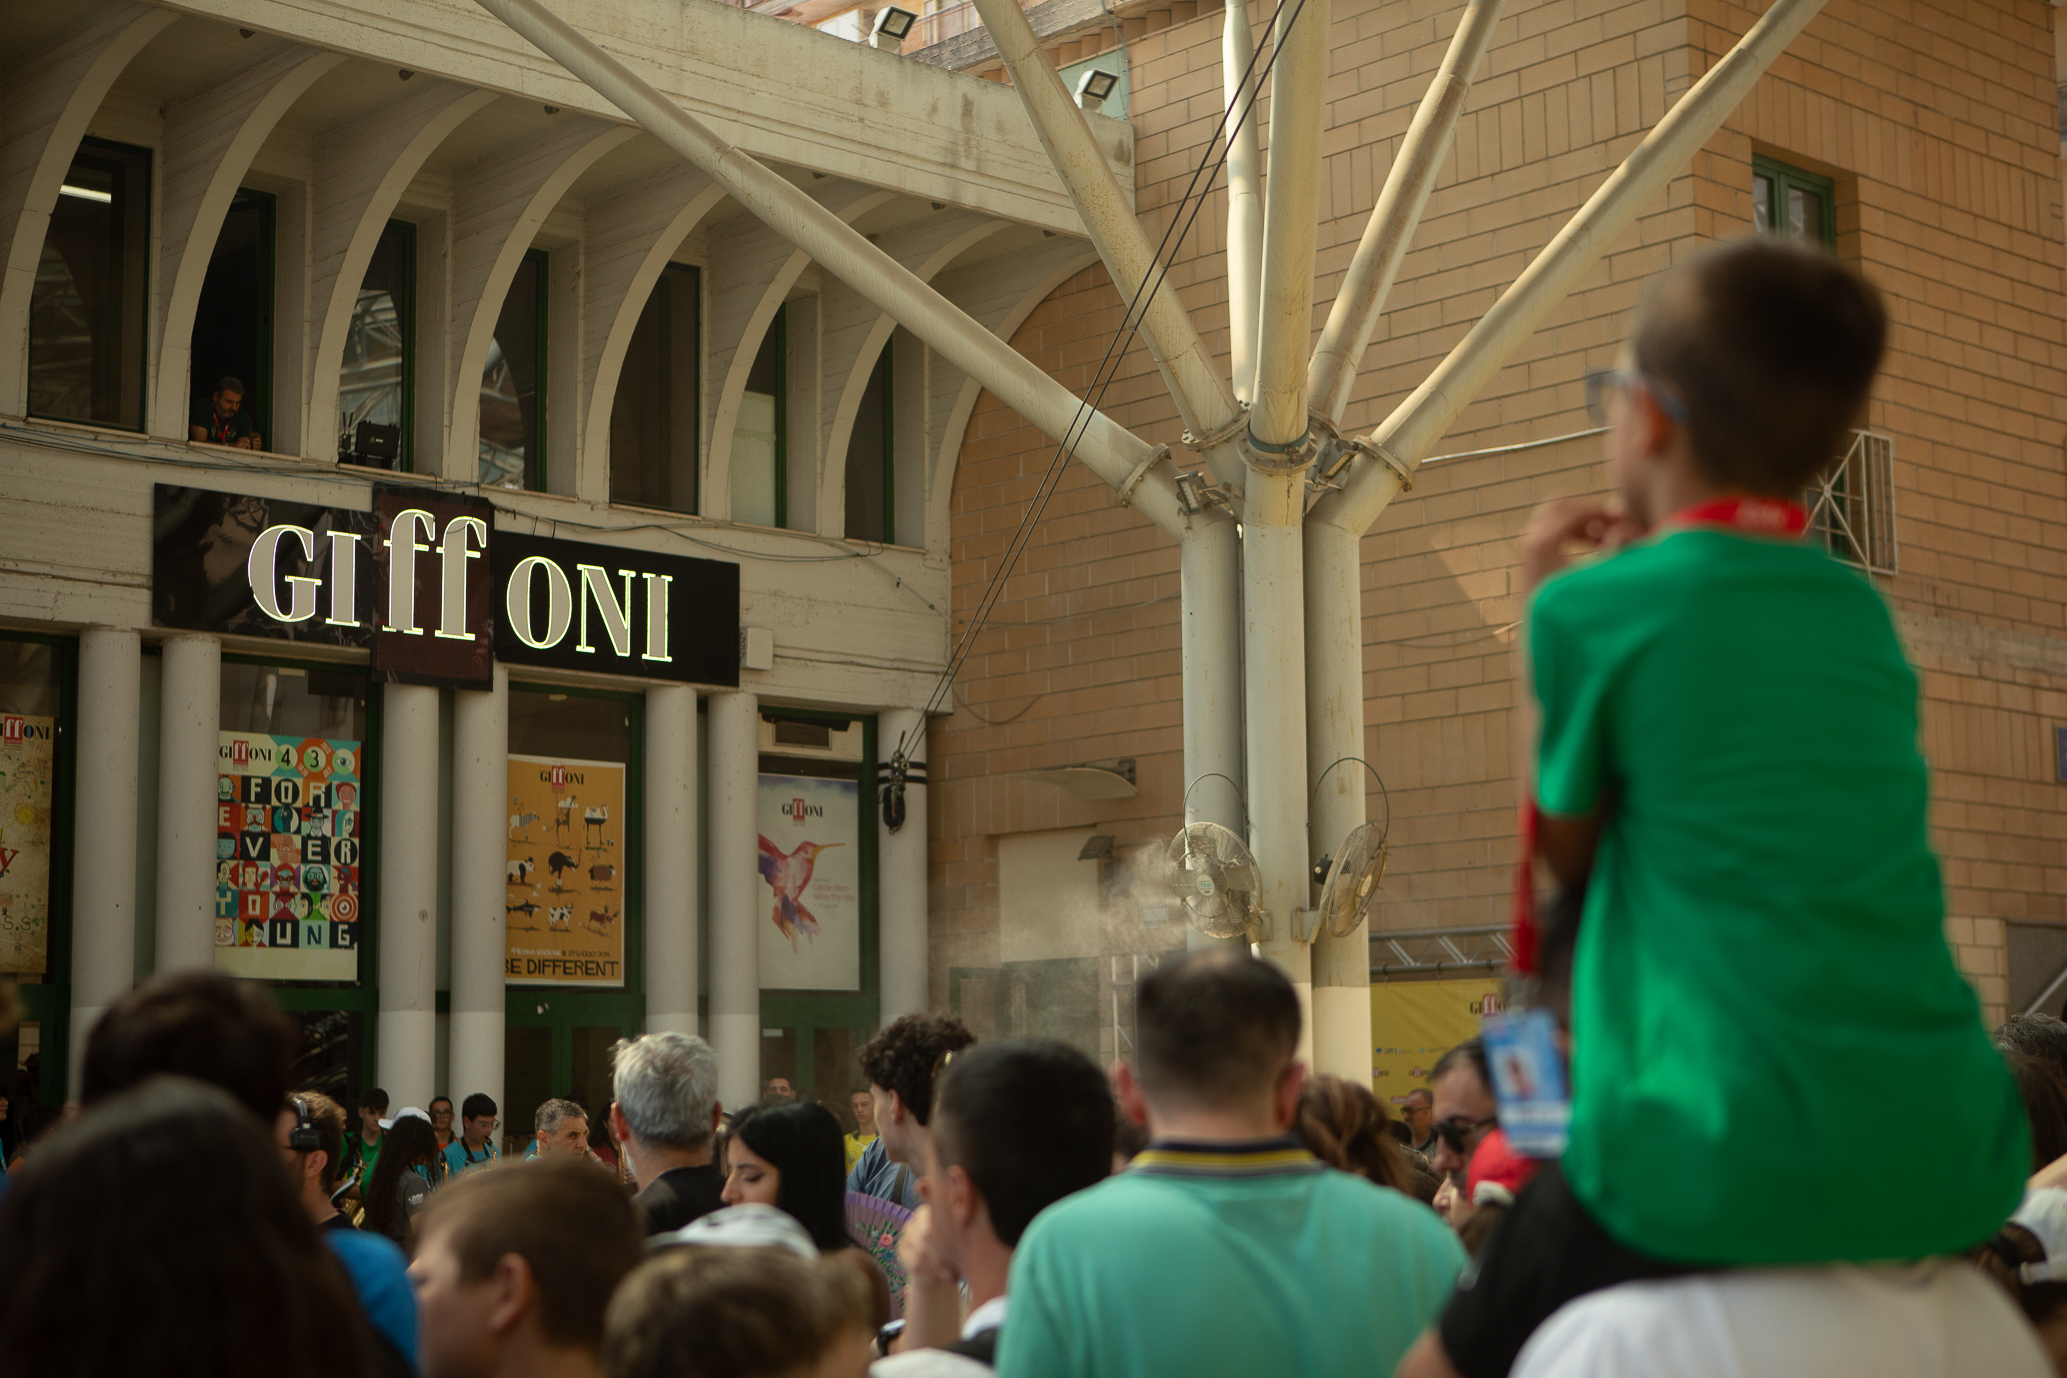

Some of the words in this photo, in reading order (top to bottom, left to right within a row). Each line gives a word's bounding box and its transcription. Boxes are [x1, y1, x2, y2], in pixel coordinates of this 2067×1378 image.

[281, 748, 291, 767] 4
[310, 749, 320, 769] 3
[250, 777, 326, 808] FOR
[276, 921, 350, 946] UNG
[527, 958, 619, 976] DIFFERENT
